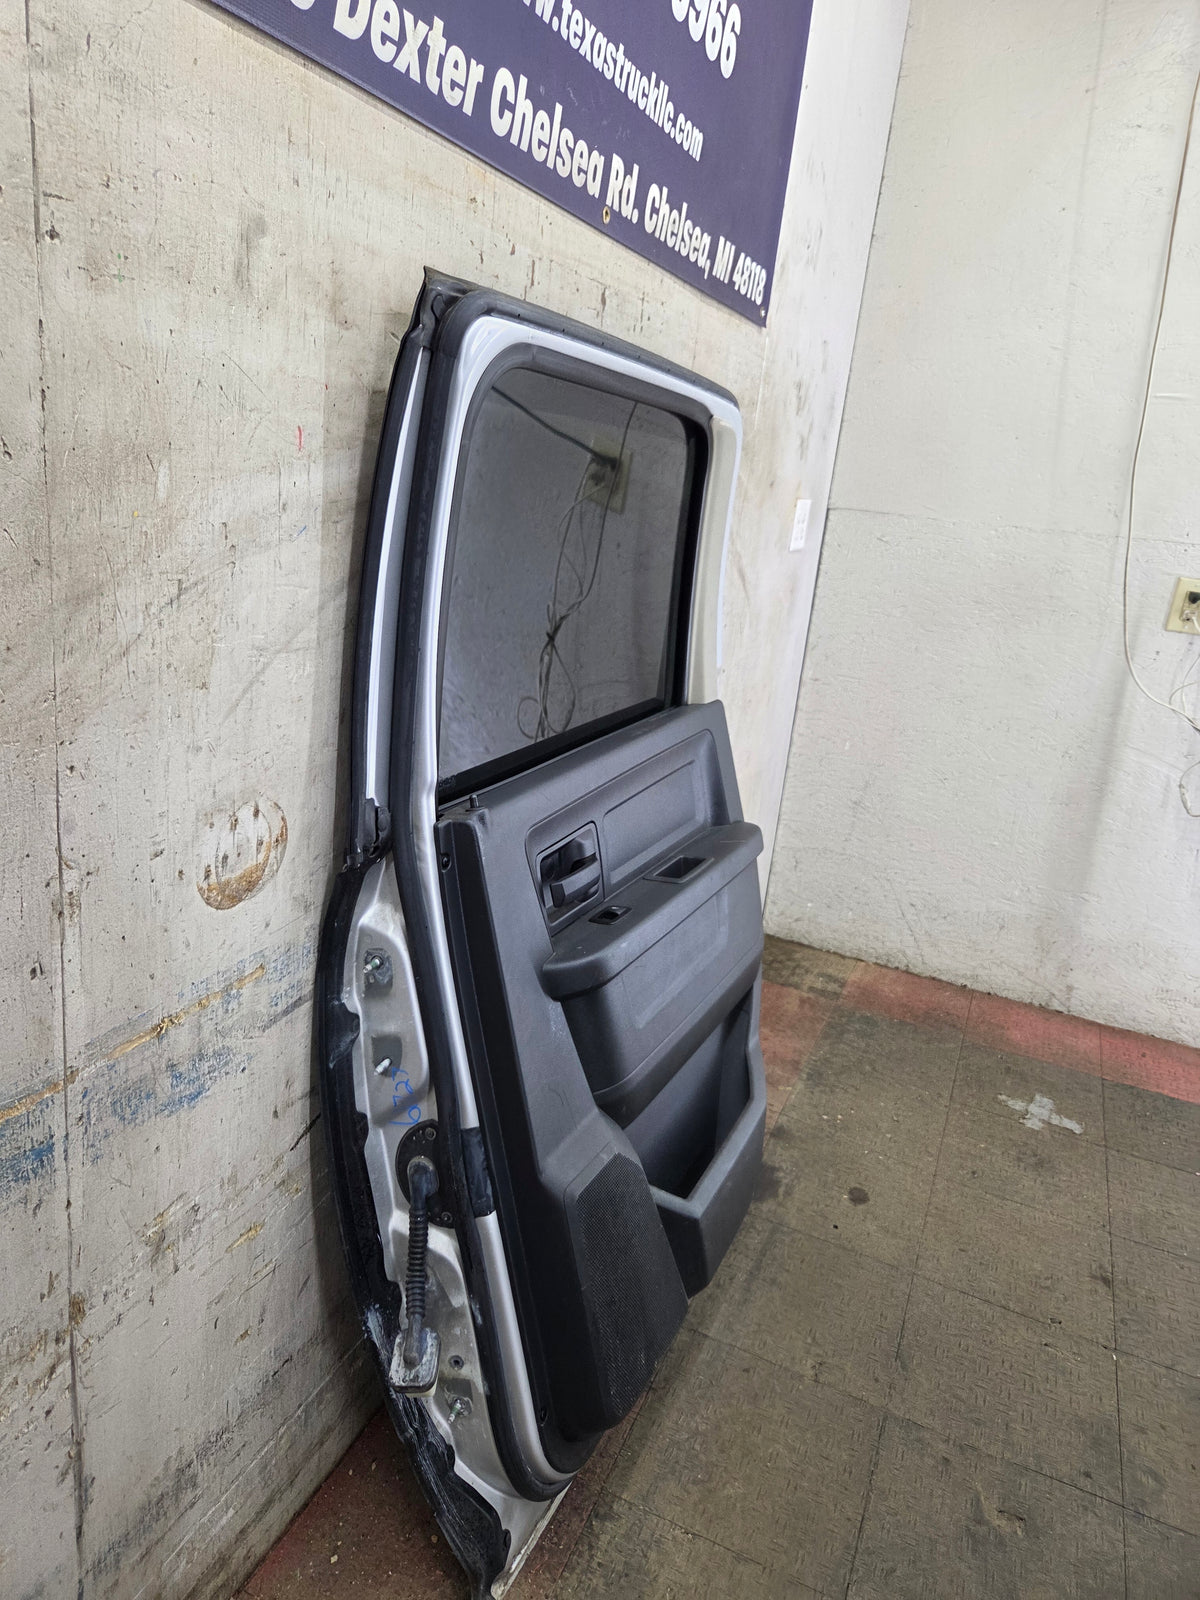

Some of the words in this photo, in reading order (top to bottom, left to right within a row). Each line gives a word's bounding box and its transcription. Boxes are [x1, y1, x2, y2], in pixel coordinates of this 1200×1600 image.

[523, 0, 704, 162] w.texastruckllc.com
[490, 67, 605, 199] Chelsea
[605, 153, 639, 224] Rd.
[644, 183, 711, 280] Chelsea,
[712, 235, 736, 284] MI
[732, 252, 767, 306] 48118
